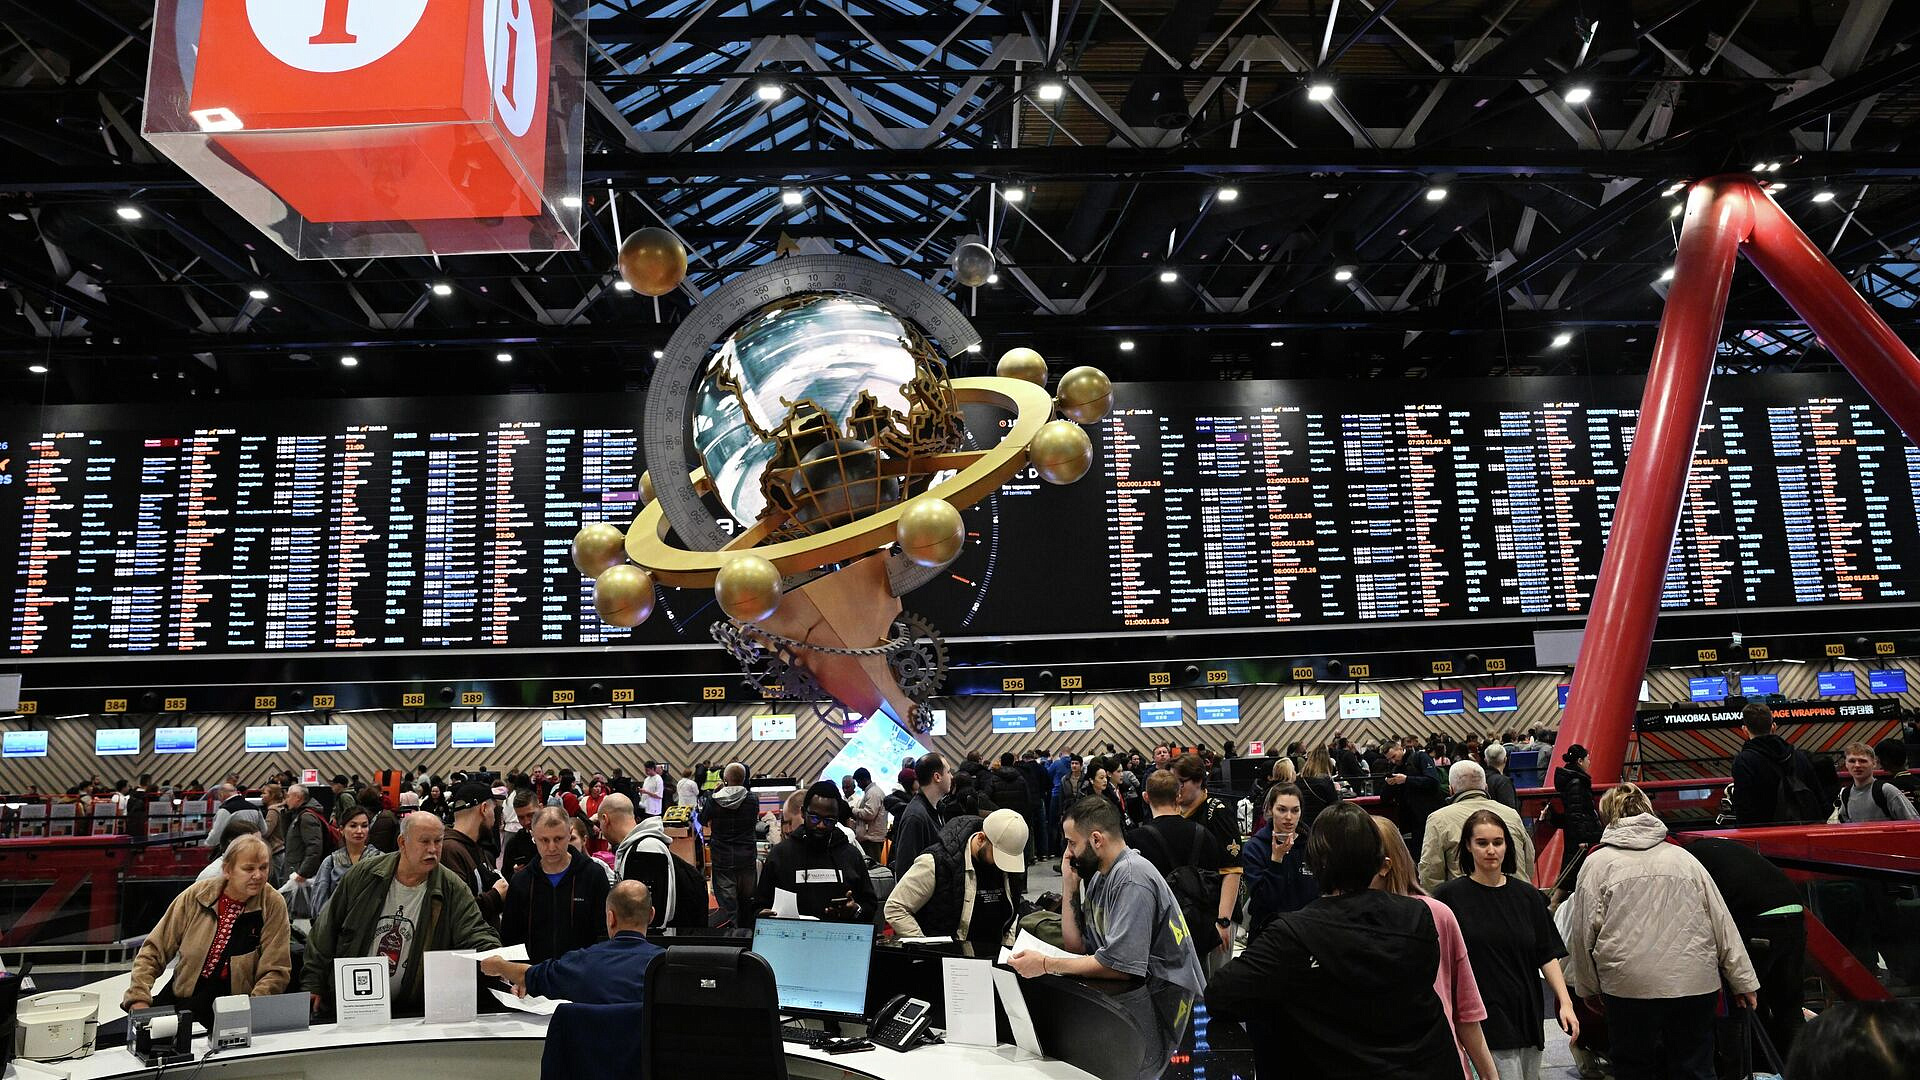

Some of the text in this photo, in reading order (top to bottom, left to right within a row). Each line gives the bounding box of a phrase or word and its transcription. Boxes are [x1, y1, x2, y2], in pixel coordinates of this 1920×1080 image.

[834, 273, 846, 281] 20
[753, 285, 769, 296] 350
[1028, 467, 1039, 479] D
[336, 629, 356, 637] 22:00
[1750, 648, 1767, 659] 407
[1826, 645, 1843, 655] 408
[1877, 643, 1894, 653] 409
[1698, 650, 1716, 661] 406
[1350, 665, 1368, 676] 401
[1434, 662, 1452, 672] 402
[1488, 660, 1505, 670] 403
[1150, 673, 1169, 685] 398
[1208, 671, 1227, 683] 399
[1294, 668, 1312, 679] 400
[1005, 678, 1024, 690] 396
[1062, 676, 1081, 688] 397
[463, 692, 482, 704] 389
[554, 691, 574, 703] 390
[613, 689, 632, 700] 391
[704, 687, 724, 698] 392
[166, 699, 185, 709] 385
[257, 697, 276, 708] 386
[315, 695, 334, 706] 387
[405, 694, 423, 705] 388
[107, 700, 126, 711] 384
[1791, 707, 1836, 718] WRAPPING
[1664, 713, 1711, 724] УПАКОВКА
